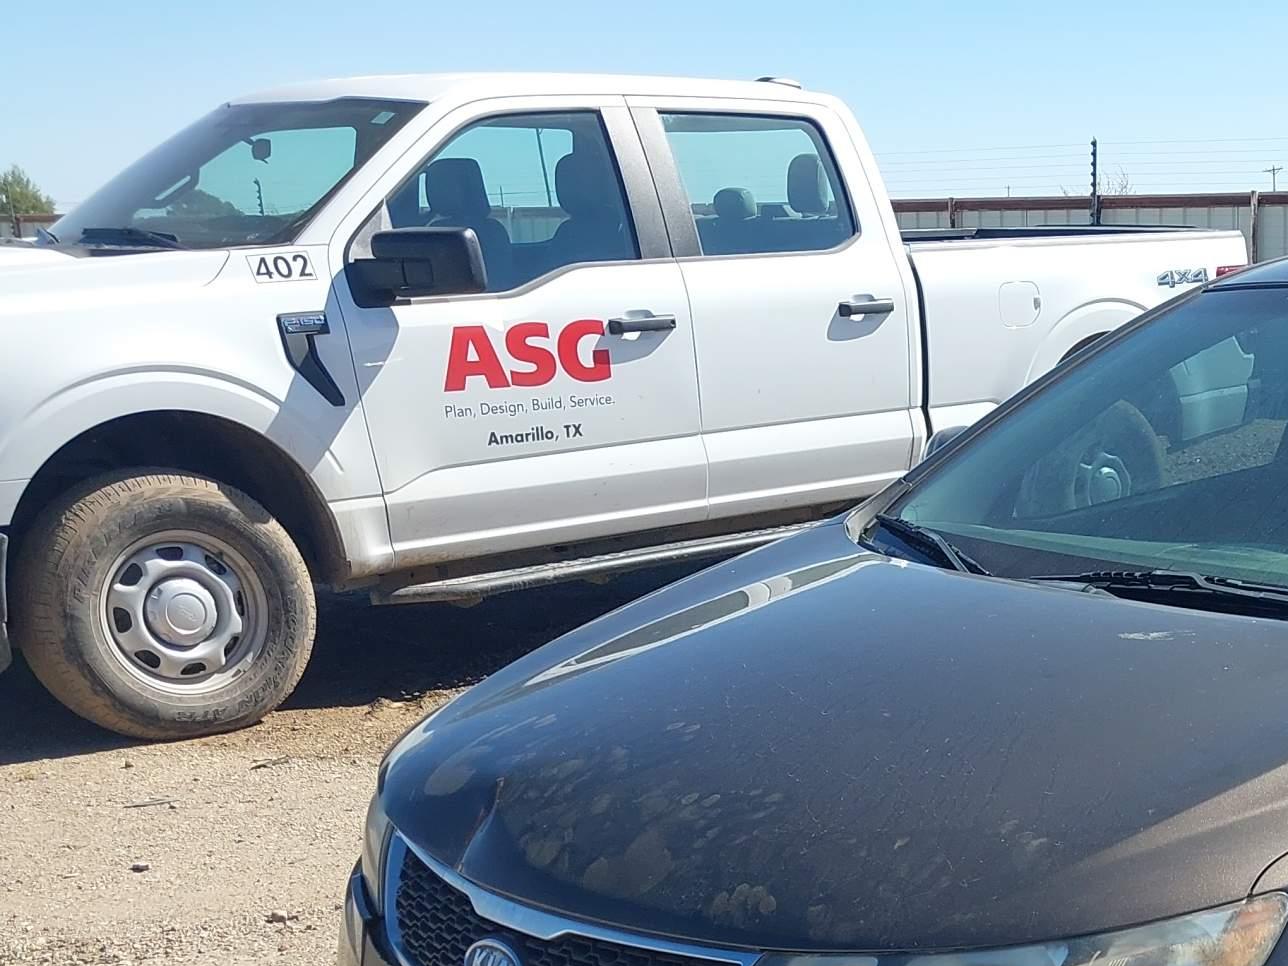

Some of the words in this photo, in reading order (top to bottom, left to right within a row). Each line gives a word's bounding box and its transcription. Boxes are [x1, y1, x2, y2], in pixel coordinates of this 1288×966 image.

[256, 254, 313, 279] 402
[444, 320, 612, 392] ASG
[444, 405, 476, 419] Plan,
[480, 401, 528, 417] Design,
[532, 395, 566, 411] Build,
[570, 393, 616, 408] Service.
[487, 426, 559, 446] Amarillo,
[564, 423, 583, 438] TX
